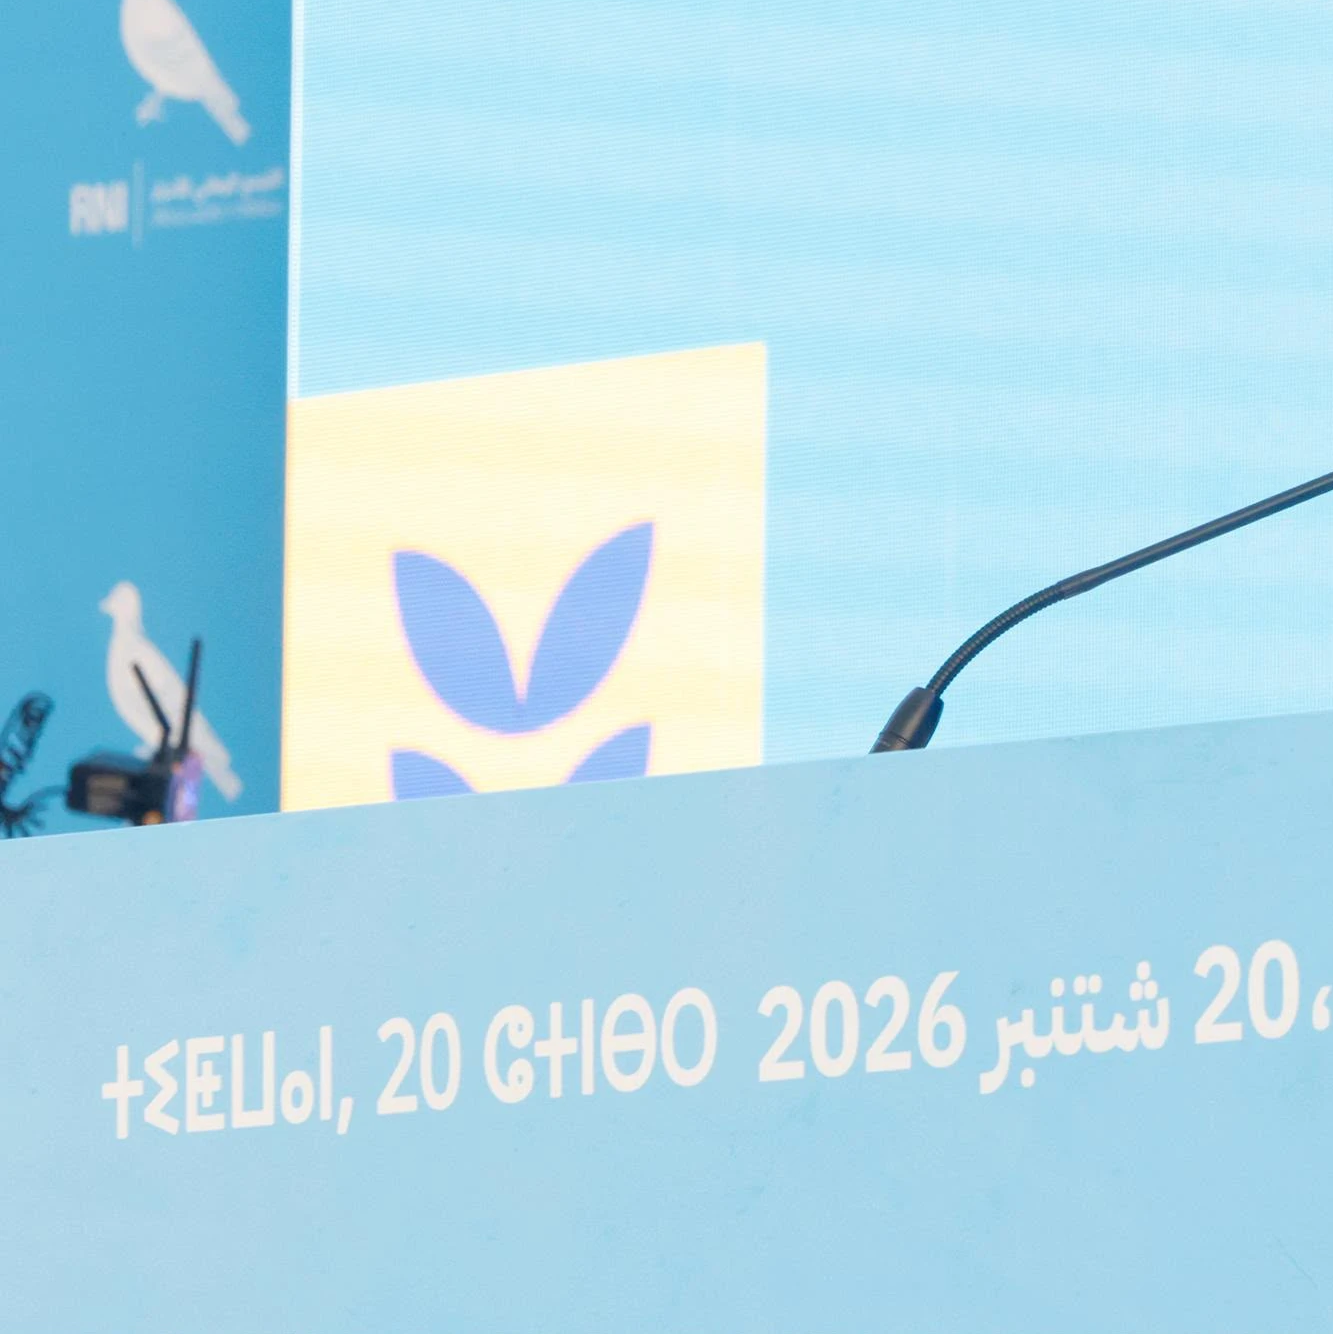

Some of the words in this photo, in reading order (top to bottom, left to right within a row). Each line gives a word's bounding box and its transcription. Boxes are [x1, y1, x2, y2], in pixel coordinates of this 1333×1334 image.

[376, 1012, 462, 1115] 20
[758, 970, 967, 1083] 2026
[979, 961, 1170, 1095] شتنبر
